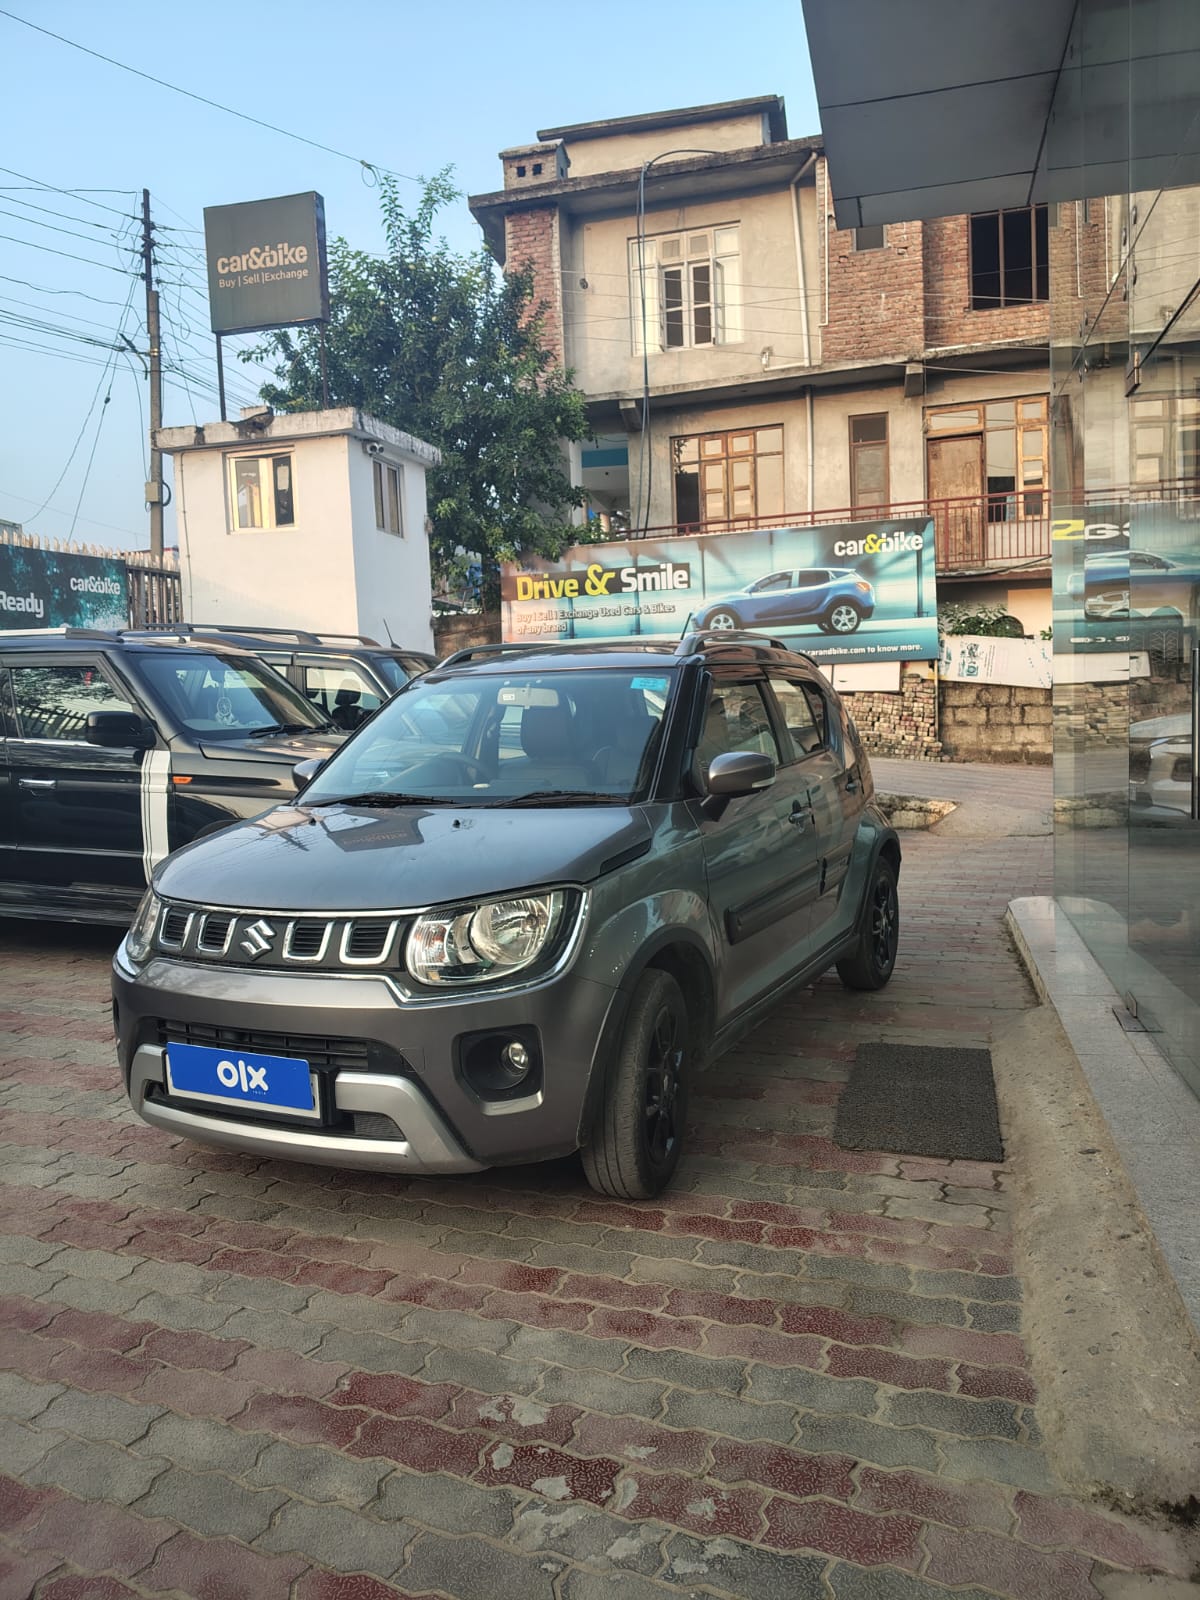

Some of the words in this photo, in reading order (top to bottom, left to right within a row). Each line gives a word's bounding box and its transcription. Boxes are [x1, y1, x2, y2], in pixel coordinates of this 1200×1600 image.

[217, 242, 308, 274] car&bike
[218, 279, 236, 288] Buy
[242, 274, 260, 284] Sell
[834, 531, 924, 556] car&bike
[70, 575, 120, 595] car&bike
[516, 573, 580, 600] Drive
[584, 563, 616, 596] &
[620, 562, 688, 592] Smile
[0, 590, 44, 618] Ready
[559, 607, 598, 620] Exchange
[600, 606, 622, 617] Used
[623, 604, 641, 616] Cars
[651, 602, 676, 614] Bikes
[878, 644, 898, 652] know
